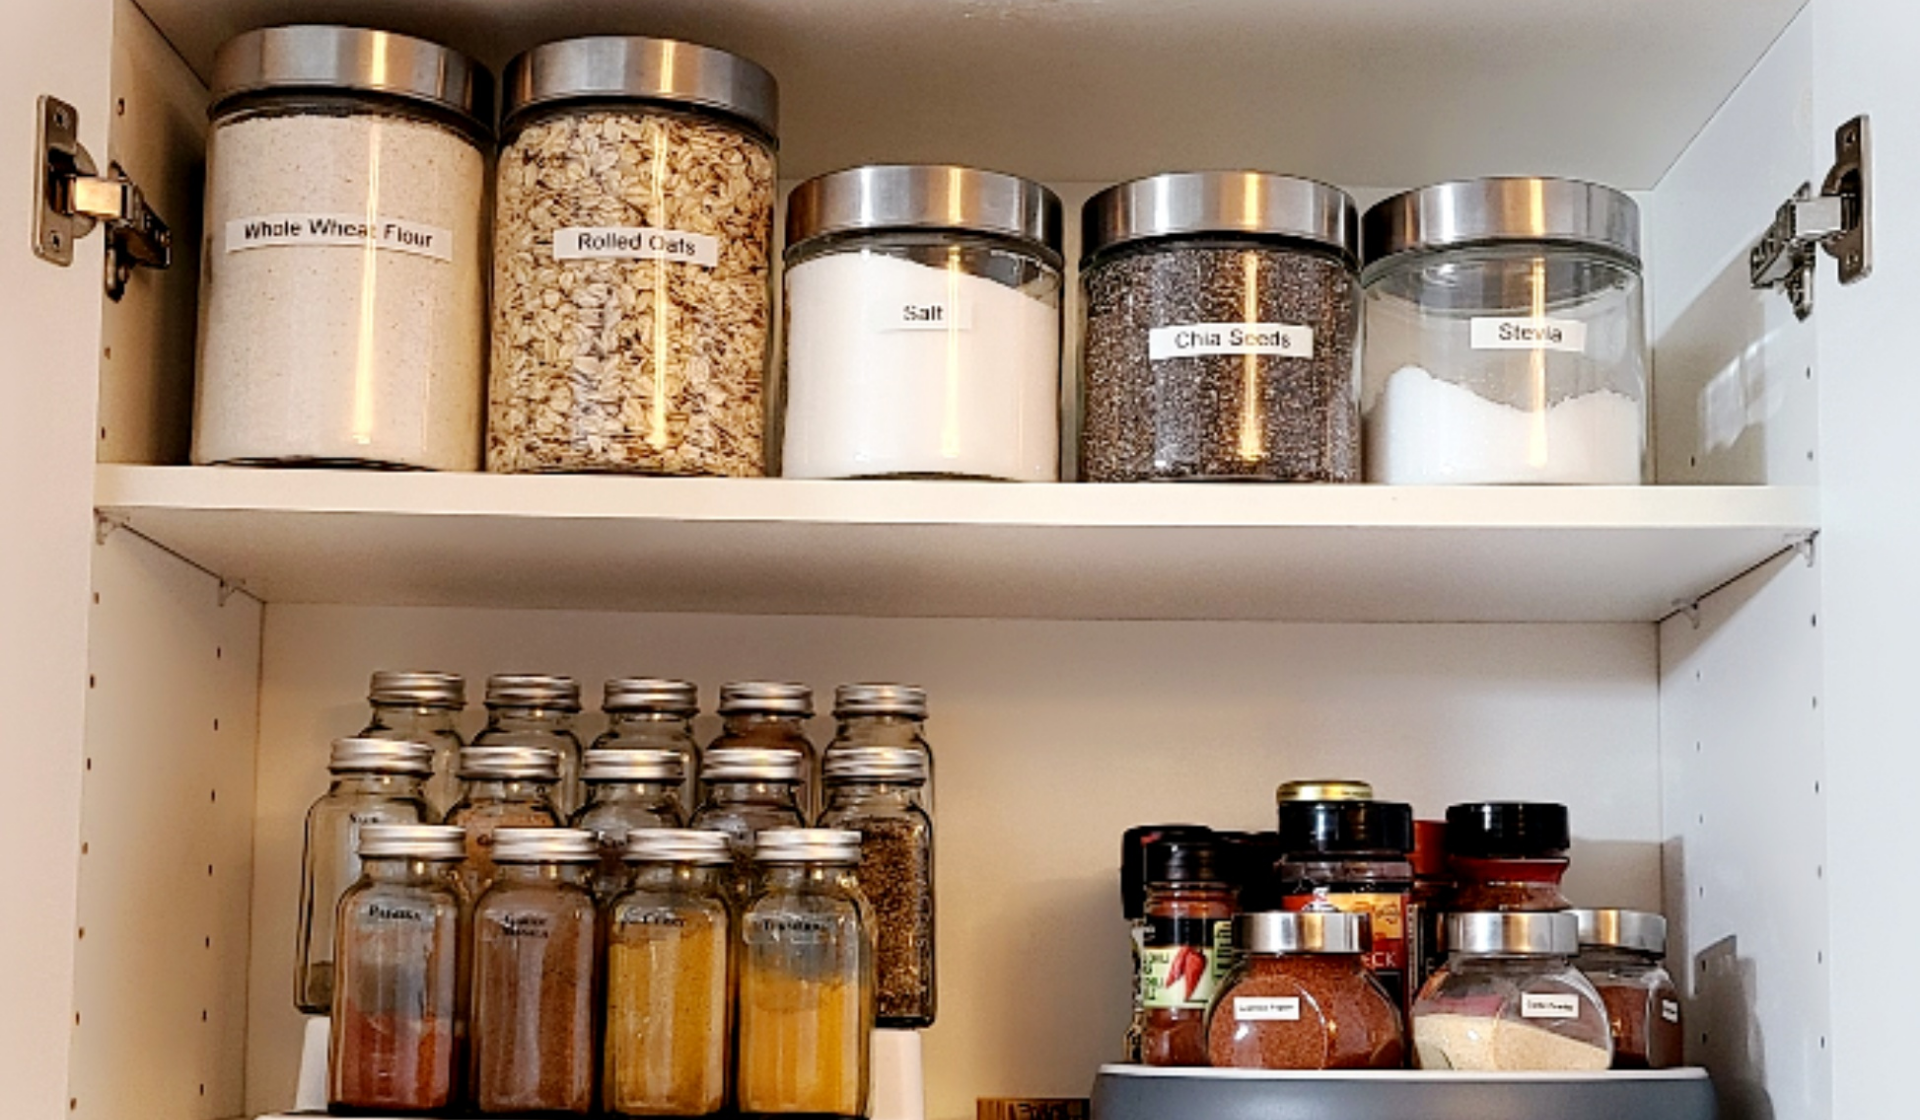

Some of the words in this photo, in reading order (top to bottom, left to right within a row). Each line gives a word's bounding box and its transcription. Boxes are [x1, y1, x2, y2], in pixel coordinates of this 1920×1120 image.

[244, 219, 301, 240] Whole
[308, 218, 377, 239] Wheat
[383, 223, 433, 248] Flour
[577, 232, 643, 251] Rolled
[649, 235, 696, 256] Oats
[903, 304, 944, 321] Salt
[1174, 331, 1221, 349] Chia
[1229, 328, 1292, 349] Seeds
[1498, 322, 1563, 343] Stevia
